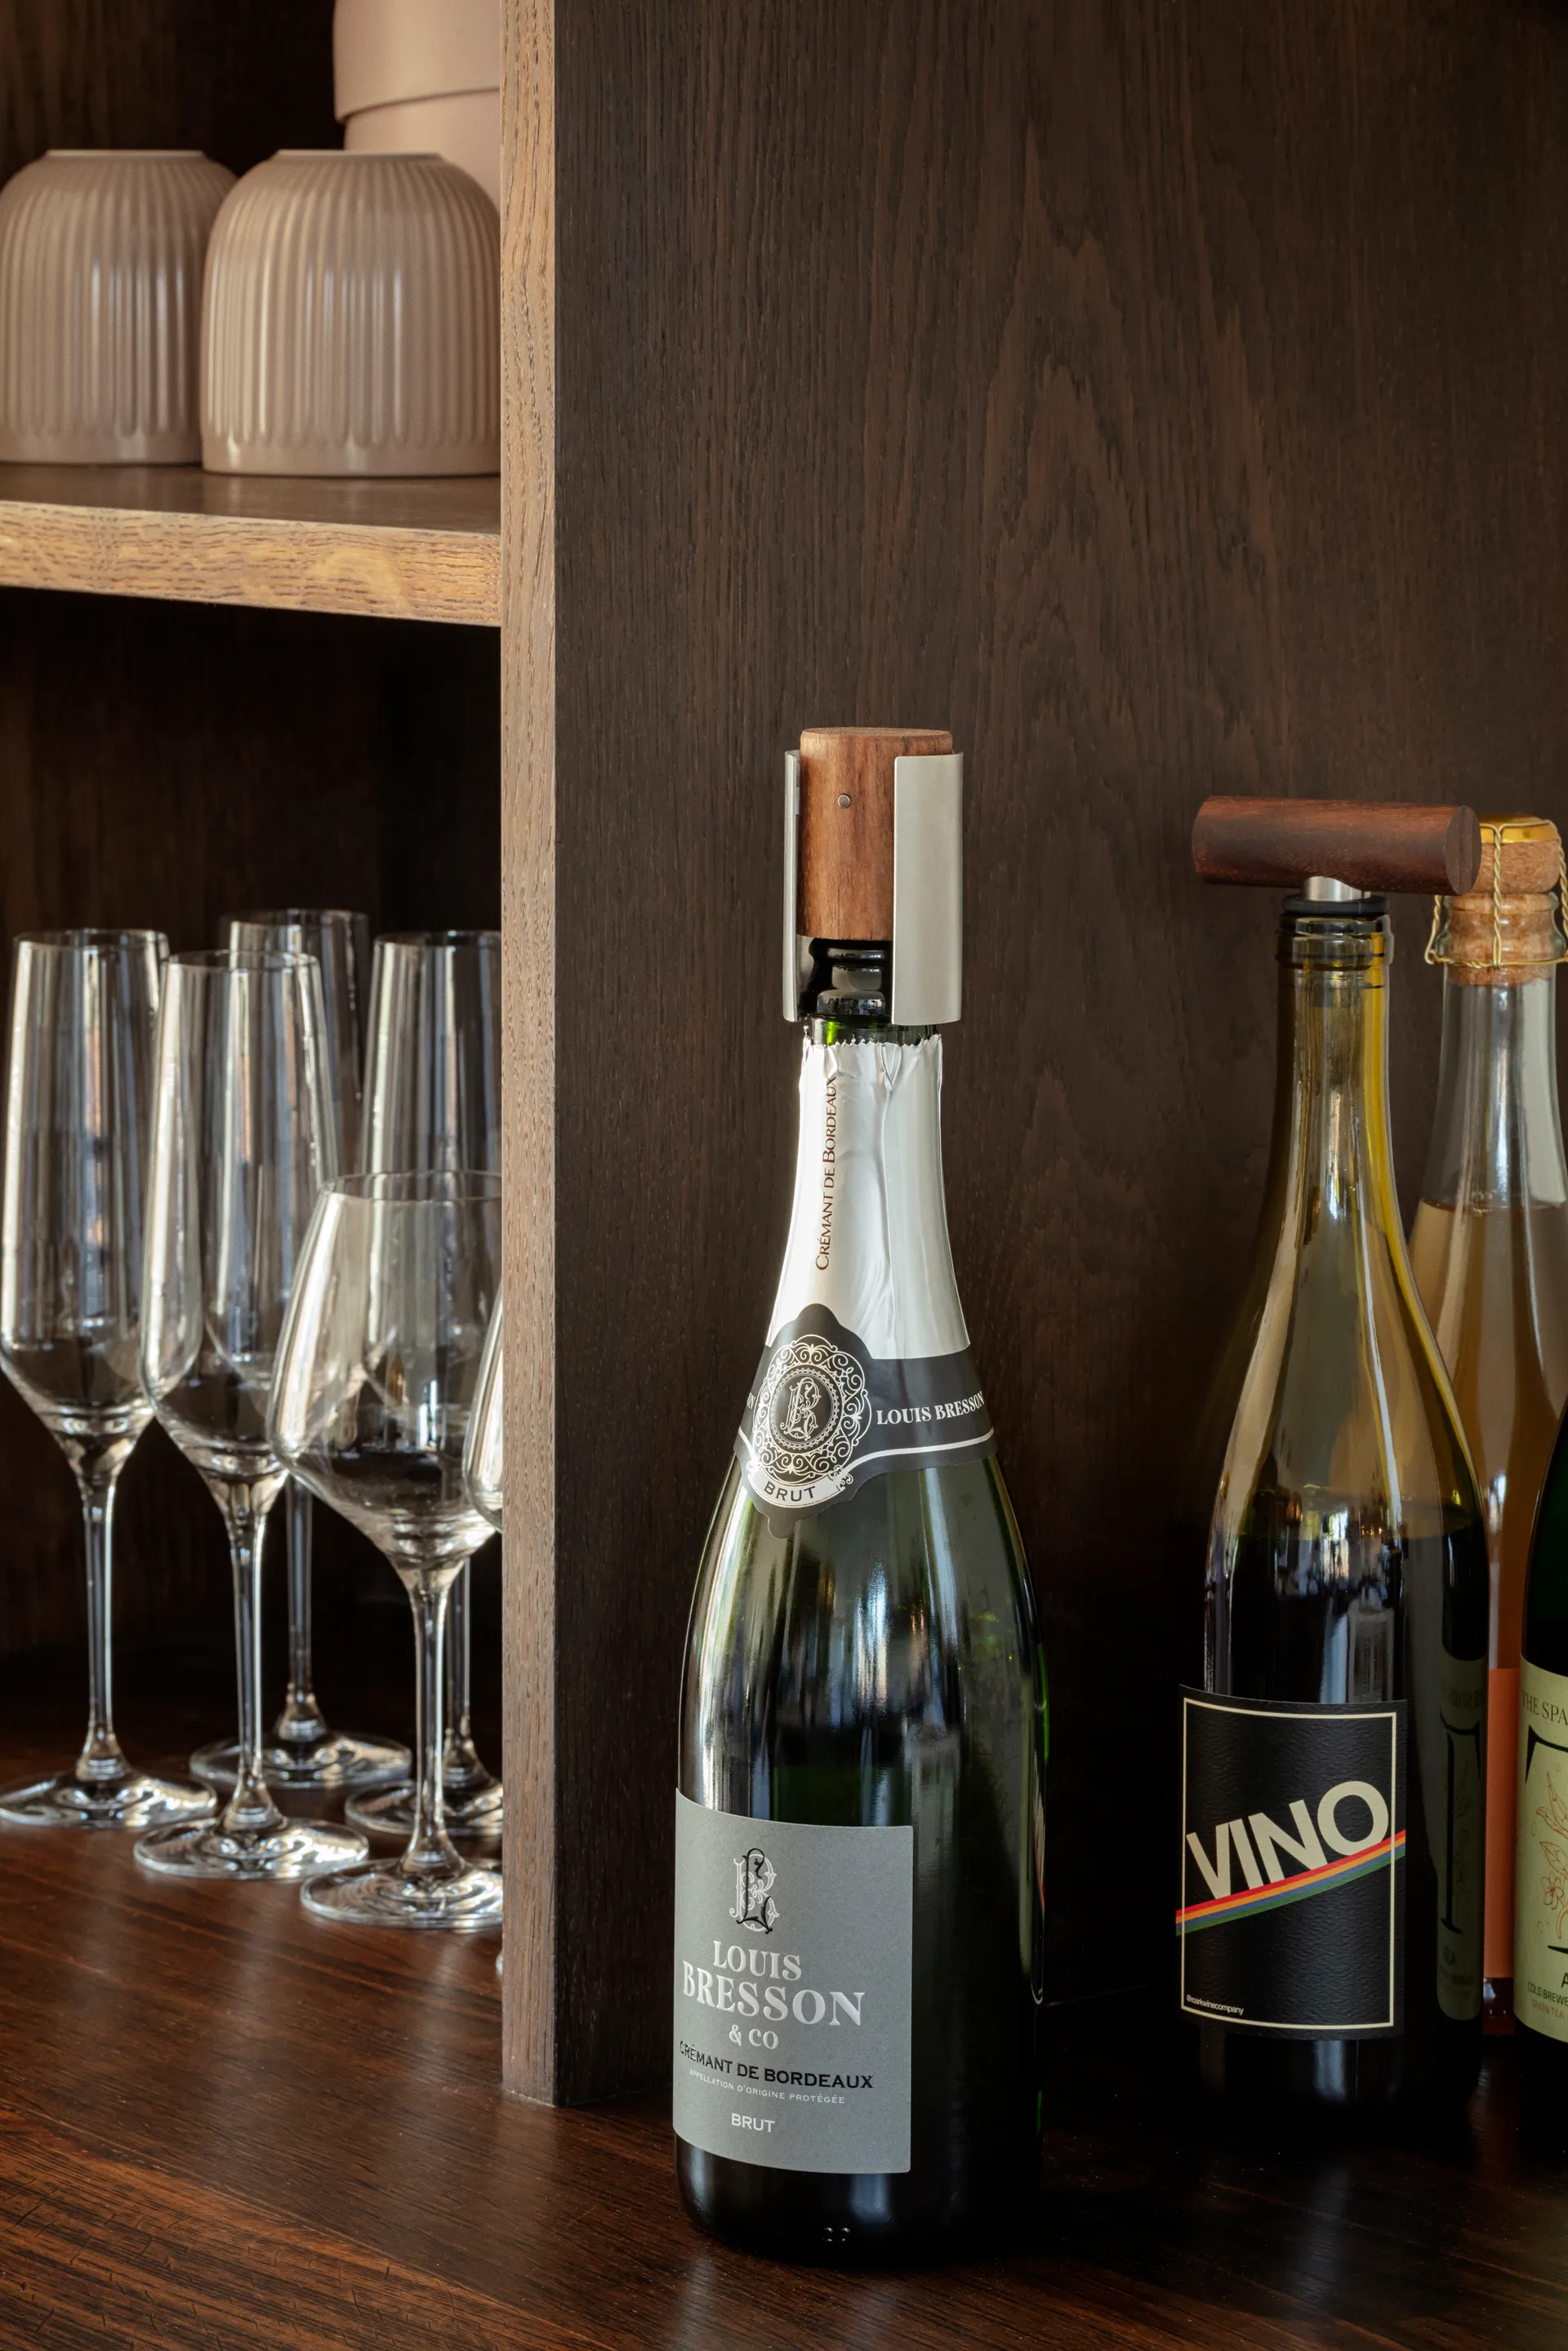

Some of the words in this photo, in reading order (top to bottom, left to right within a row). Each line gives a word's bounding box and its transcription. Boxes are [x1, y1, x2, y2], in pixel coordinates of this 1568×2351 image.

[822, 1076, 836, 1164] BORDEAUX
[825, 1167, 835, 1188] DE
[876, 1406, 932, 1425] LOUIS
[935, 1391, 985, 1421] BRESSON
[764, 1481, 816, 1502] BRUT
[1522, 1690, 1539, 1716] THE
[1186, 1780, 1388, 1900] VINO
[713, 1939, 803, 1981] LOUIS
[683, 1960, 866, 2026] BRESSON
[1527, 1981, 1542, 1997] COLD
[1551, 2007, 1564, 2018] TEA
[729, 2024, 742, 2046] &
[749, 2028, 779, 2050] CO
[679, 2040, 733, 2074] CRÉMANT
[737, 2063, 759, 2080] DE
[764, 2068, 874, 2089] BORDEAUX
[689, 2068, 734, 2091] APPELLATION
[737, 2085, 785, 2099] D'ORIGINE
[789, 2093, 844, 2104] PROTÉGÉE
[731, 2113, 775, 2133] BRUT
